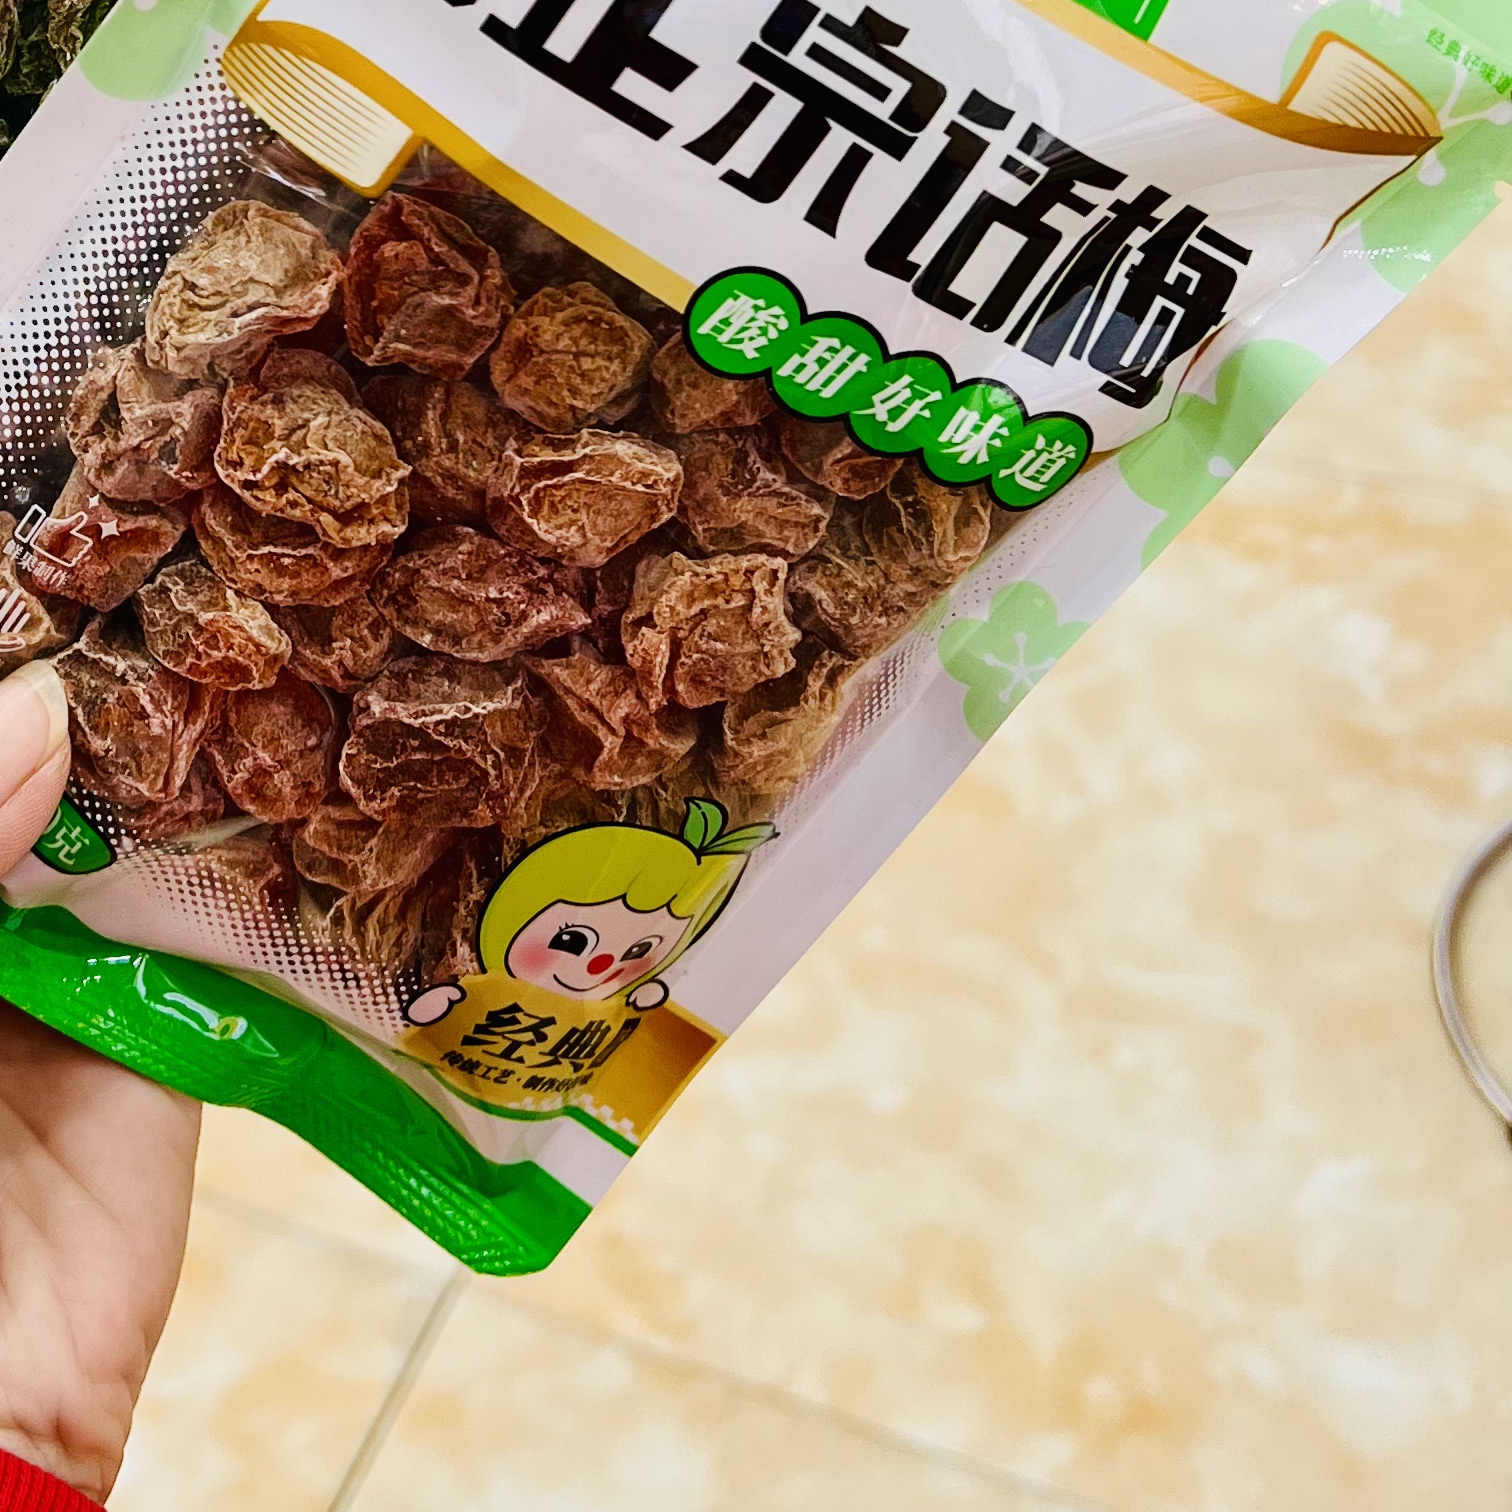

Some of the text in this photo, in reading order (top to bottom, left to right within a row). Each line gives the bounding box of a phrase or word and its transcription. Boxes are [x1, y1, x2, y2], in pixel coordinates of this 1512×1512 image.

[695, 288, 1079, 496] 酸甜好味道
